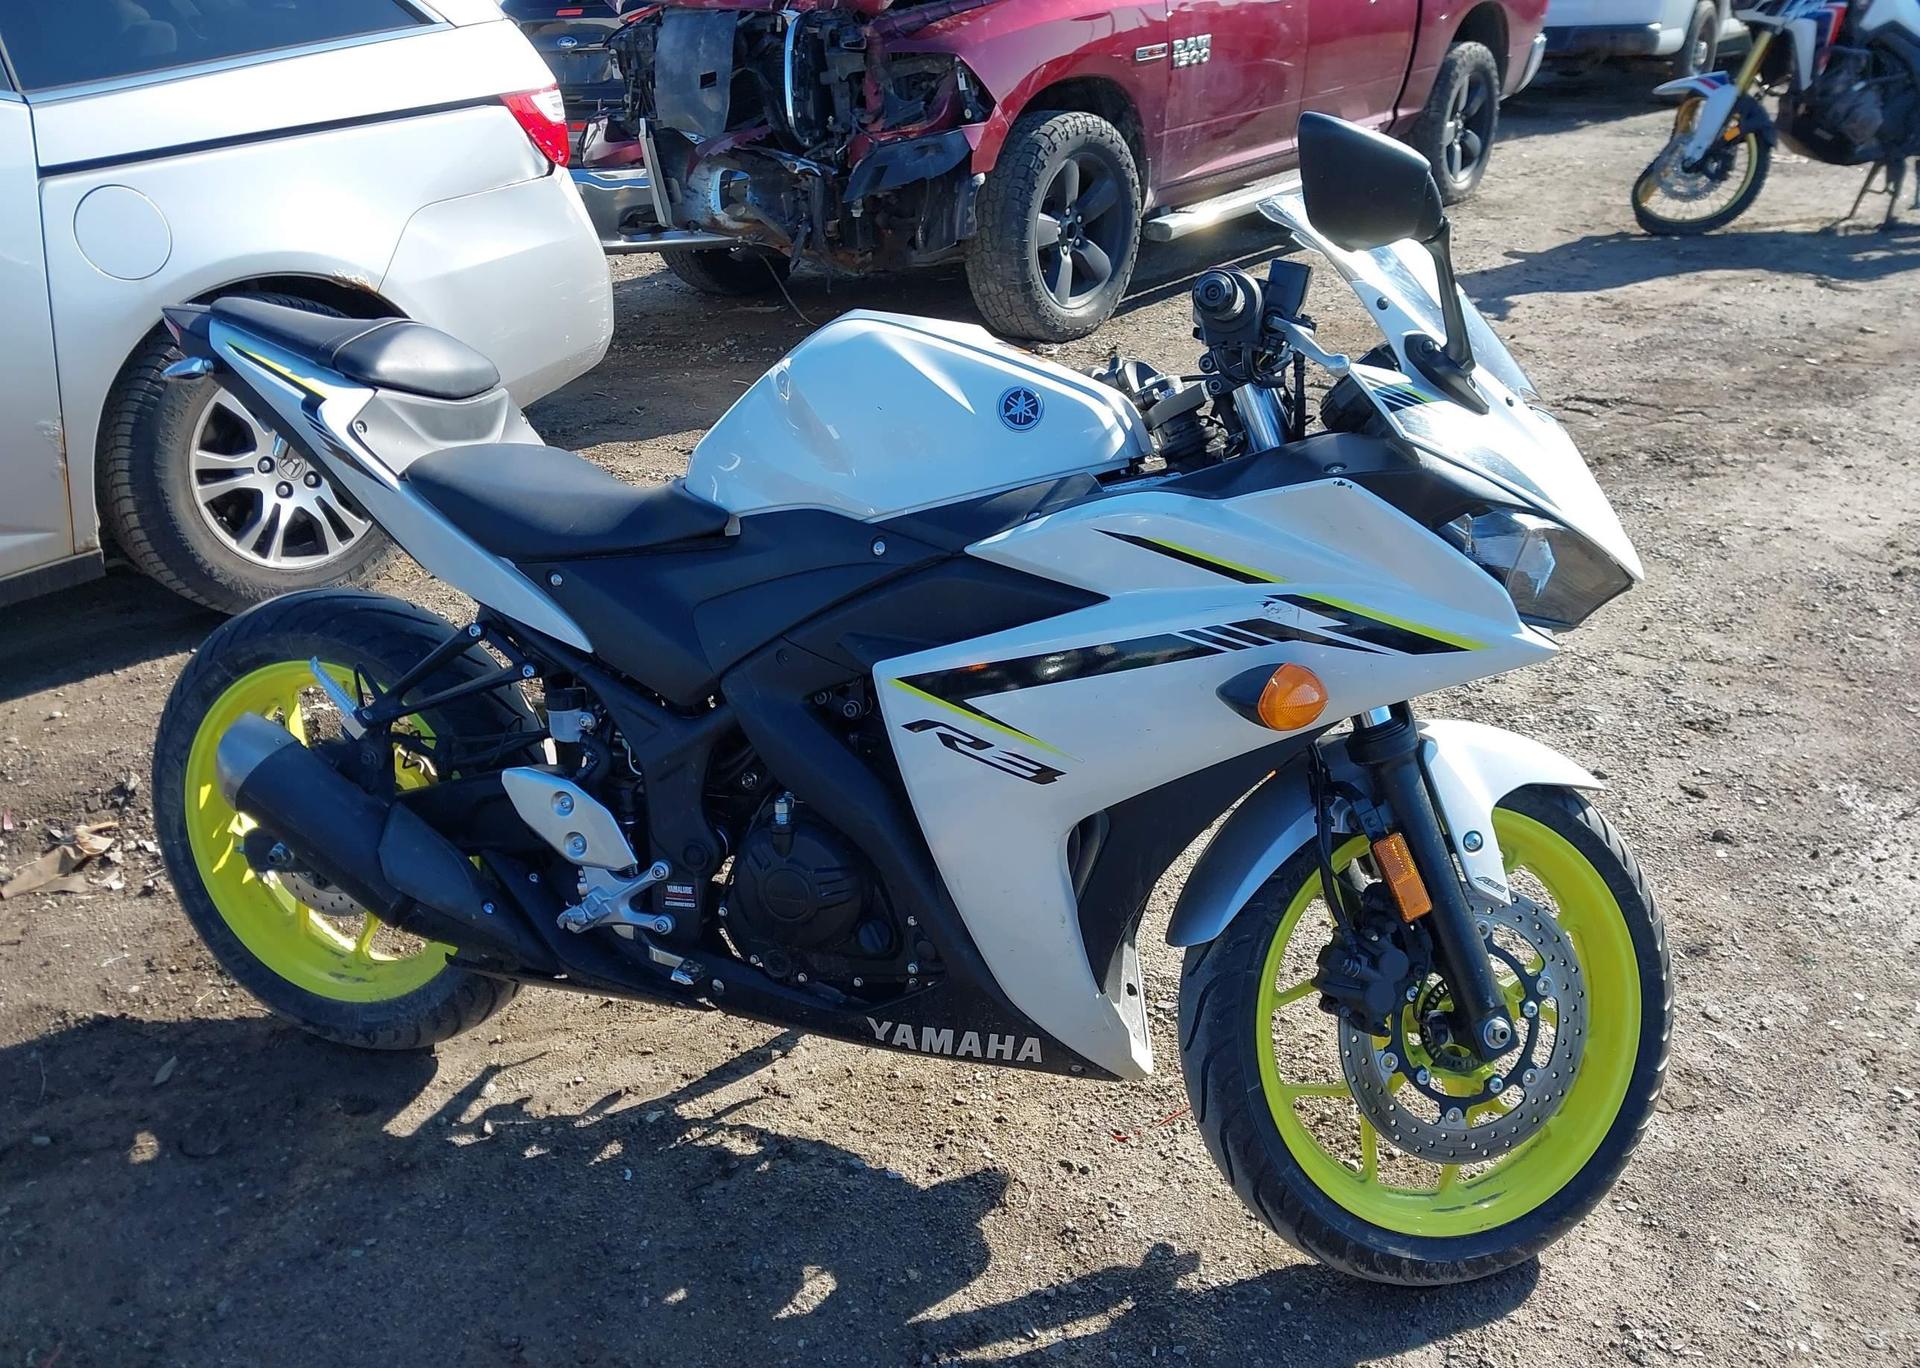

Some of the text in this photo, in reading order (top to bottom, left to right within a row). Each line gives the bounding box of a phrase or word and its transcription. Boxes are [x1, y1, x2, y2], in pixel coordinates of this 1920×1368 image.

[1173, 34, 1212, 54] RAM
[1173, 48, 1211, 67] 1500
[901, 719, 1067, 785] R3
[866, 1016, 1043, 1063] YAMAHA
